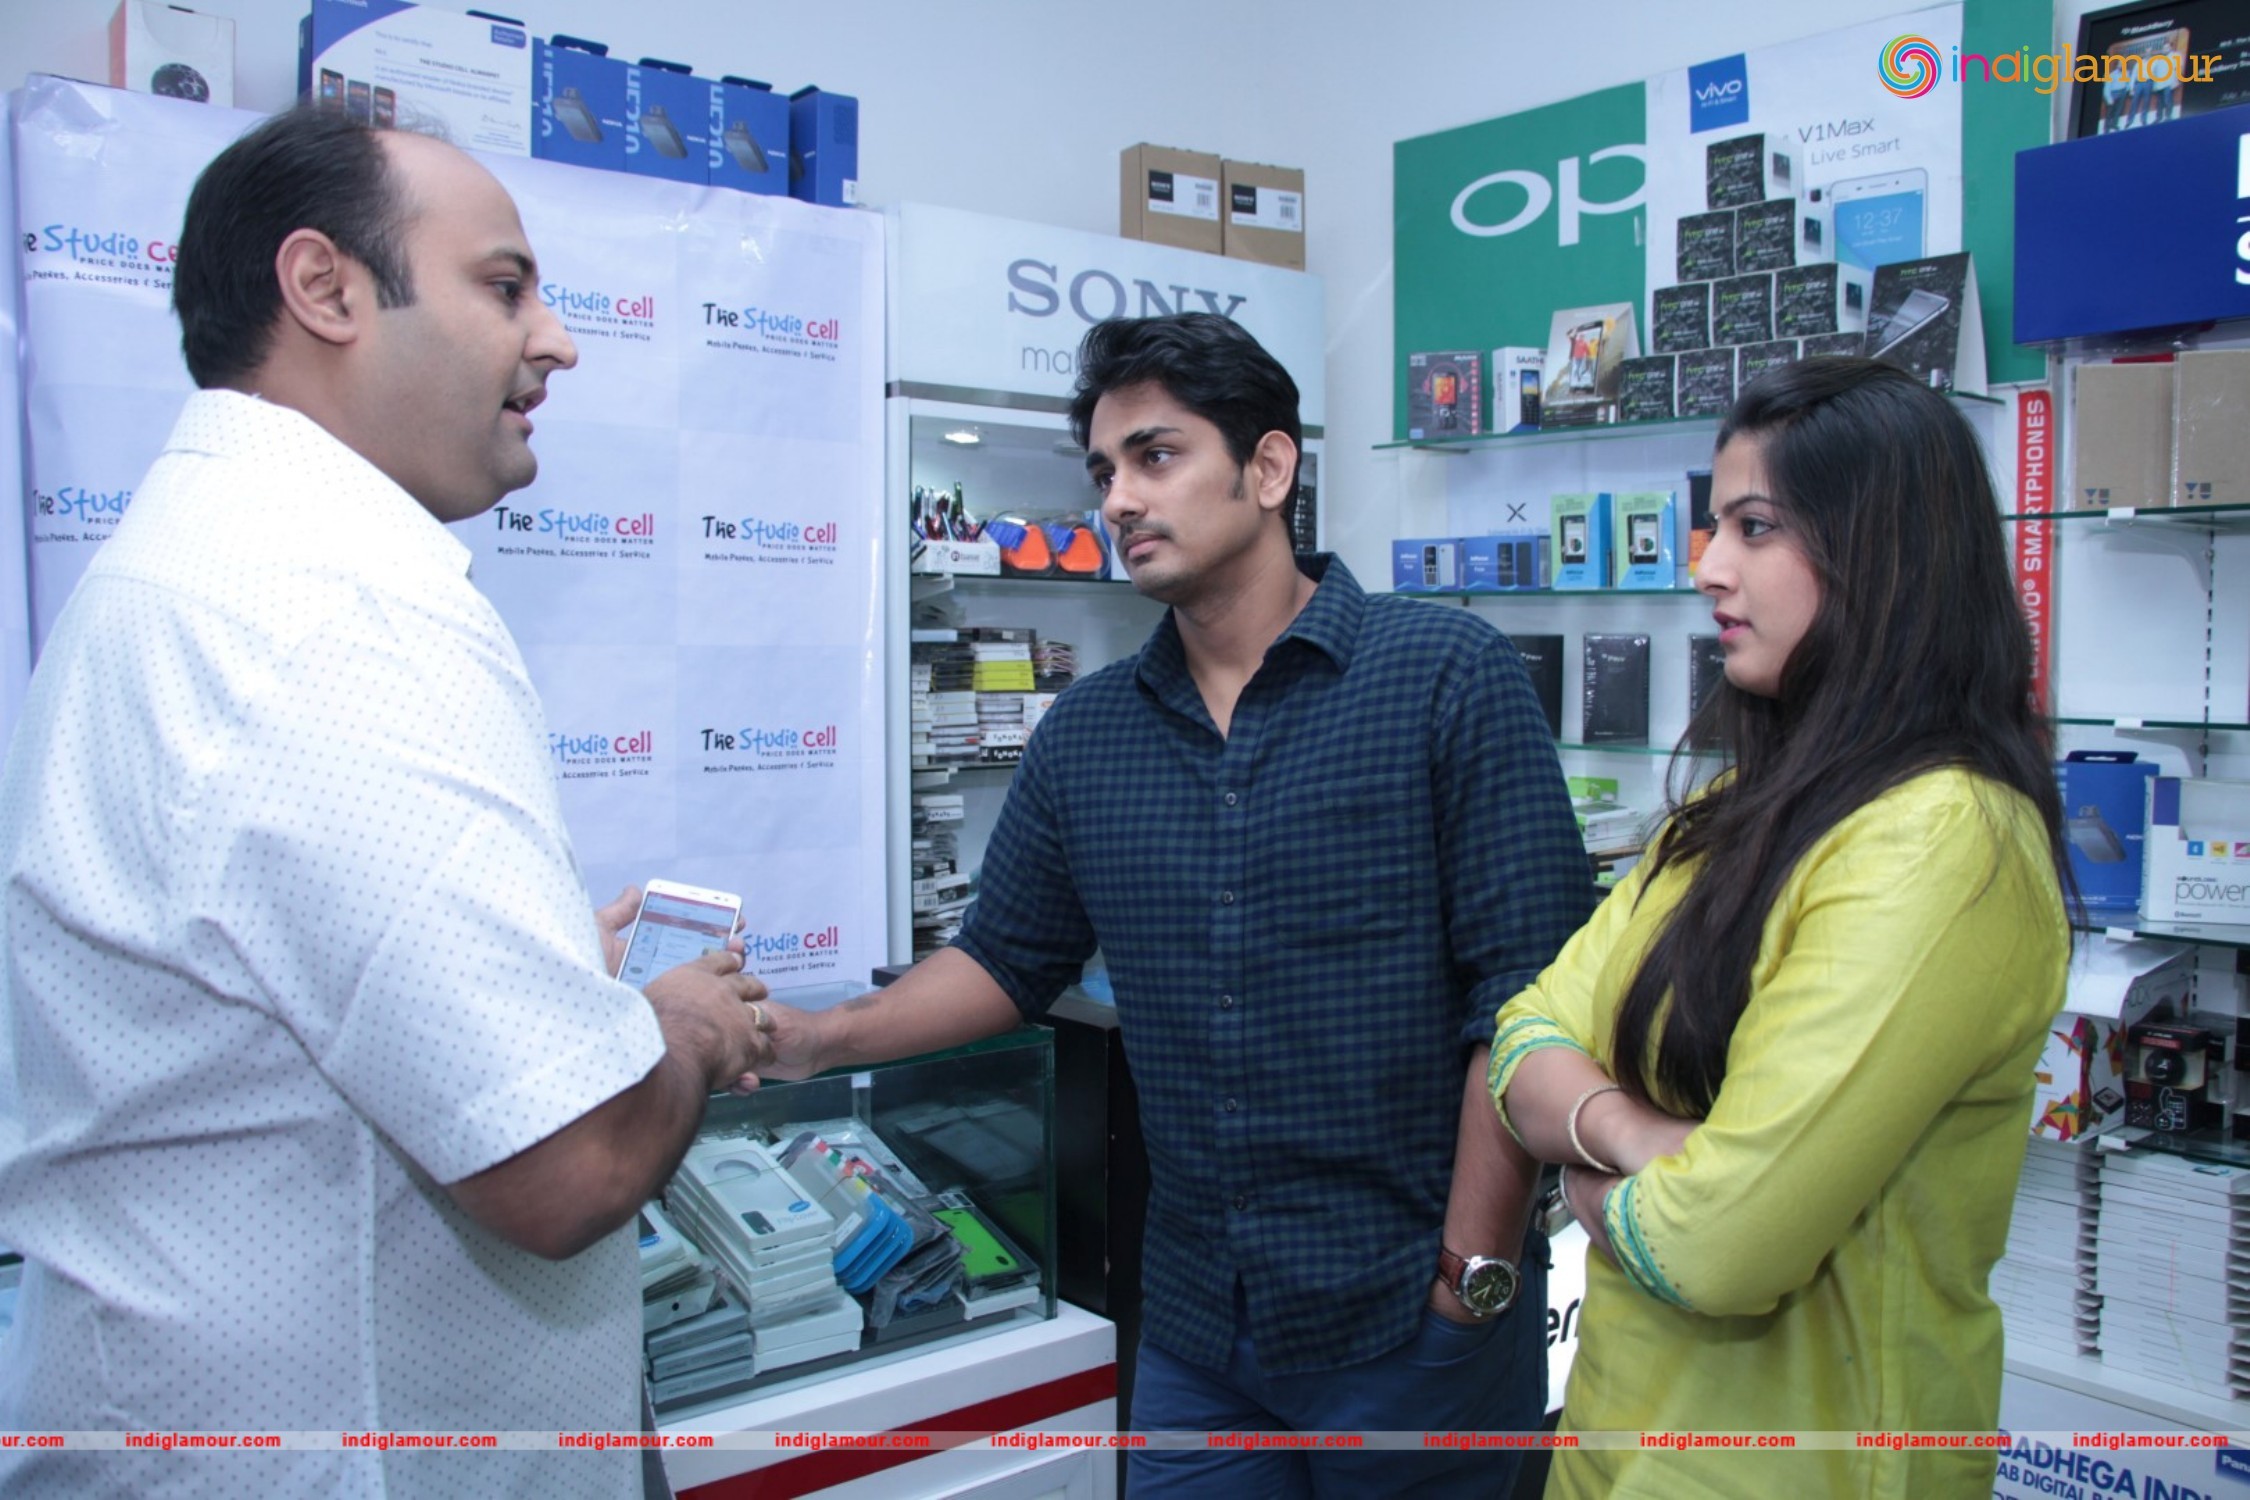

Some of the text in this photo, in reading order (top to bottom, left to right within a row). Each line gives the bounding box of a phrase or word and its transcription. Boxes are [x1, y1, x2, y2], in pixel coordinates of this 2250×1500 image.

[1695, 79, 1743, 101] vivo
[1798, 116, 1876, 144] V1Max
[1810, 136, 1901, 166] Live Smart
[43, 224, 140, 261] Studio
[79, 256, 115, 268] PRICE
[703, 303, 739, 327] The
[2024, 398, 2045, 572] SMARTPHONES
[58, 486, 132, 521] Studi
[493, 506, 533, 532] The
[702, 515, 737, 539] The
[701, 728, 735, 751] The
